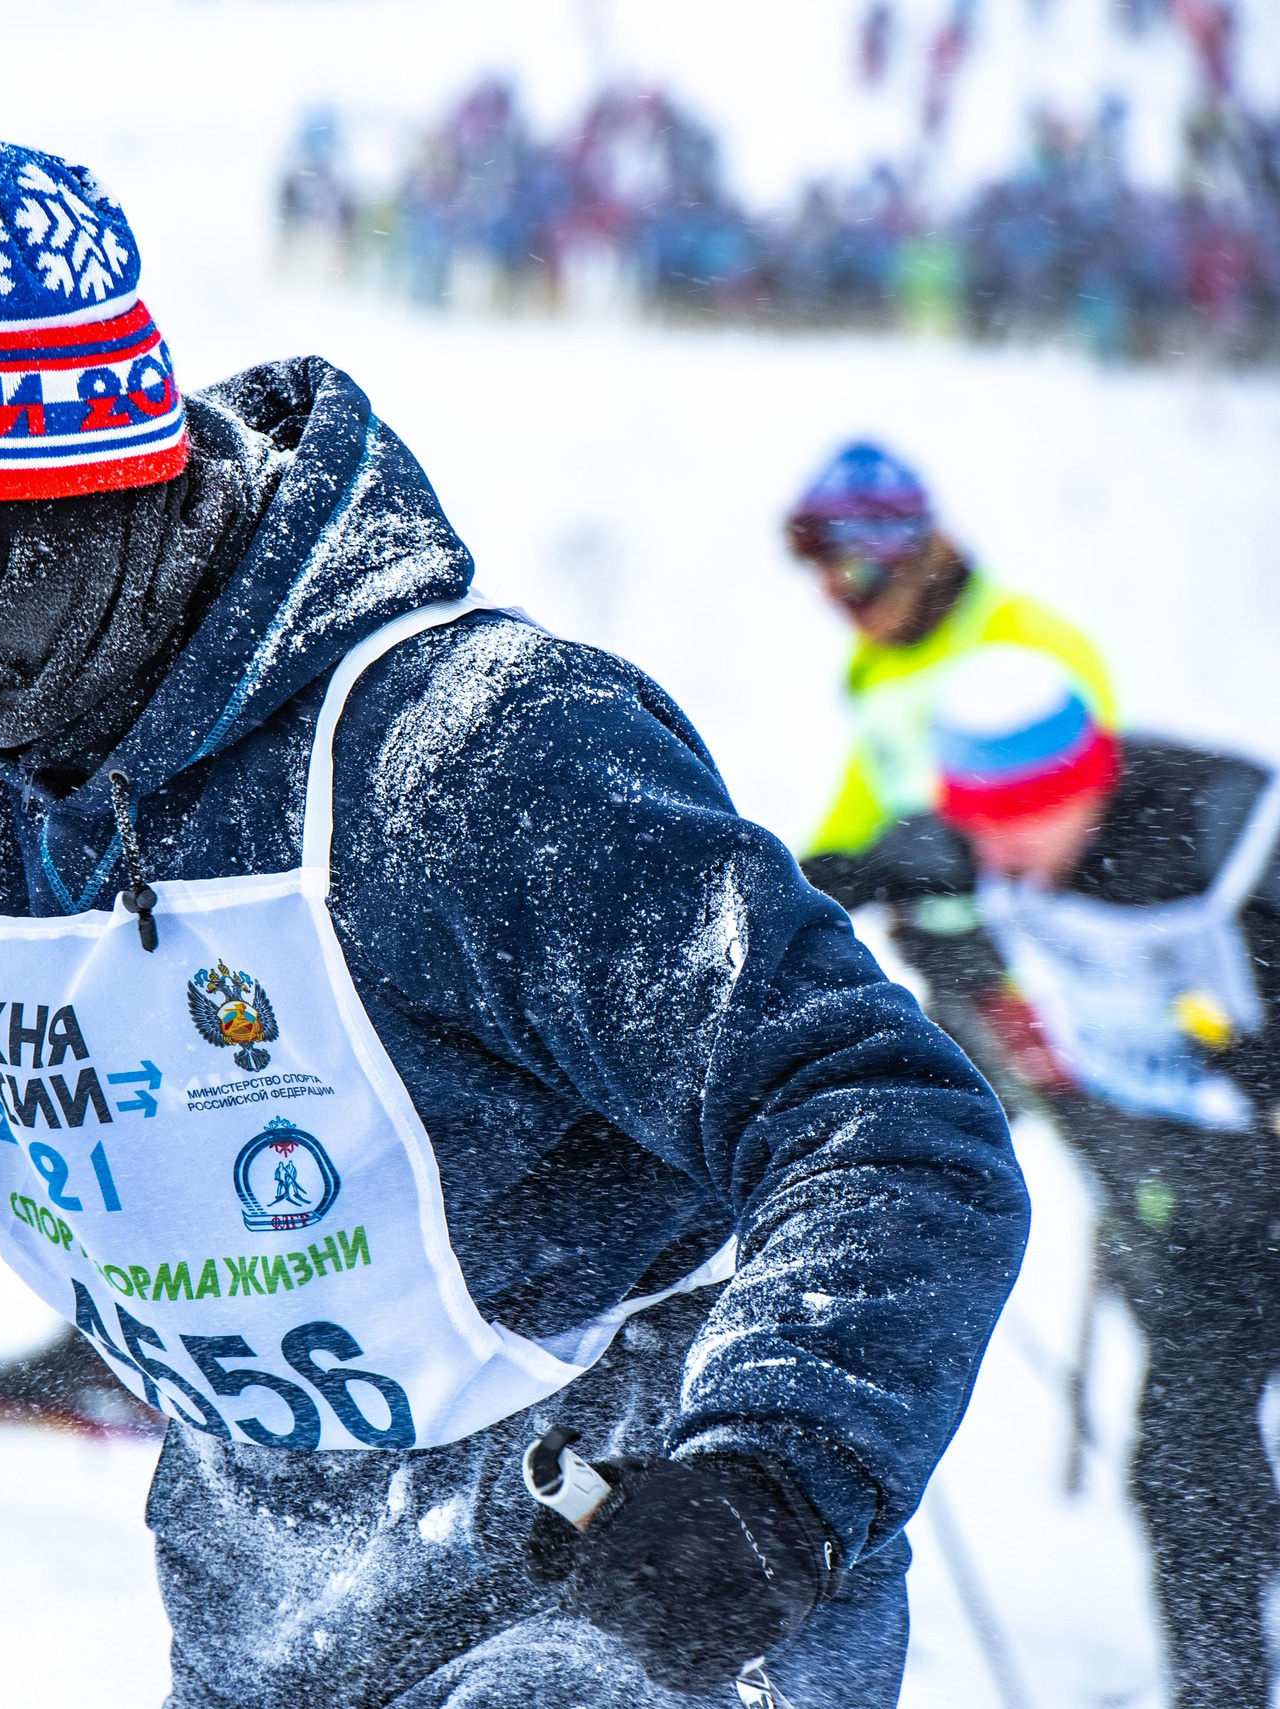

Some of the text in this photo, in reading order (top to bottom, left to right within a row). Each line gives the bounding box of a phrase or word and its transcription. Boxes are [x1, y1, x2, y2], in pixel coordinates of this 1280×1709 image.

[77, 341, 178, 432] 20
[187, 1073, 322, 1099] МИНИСТЕРСТВО СПОРТА
[187, 1086, 335, 1112] РОССИЙСКОЙ ФЕДЕРАЦИИ
[94, 1260, 221, 1301] ОРМА
[223, 1224, 371, 1297] ЖИЗНИ
